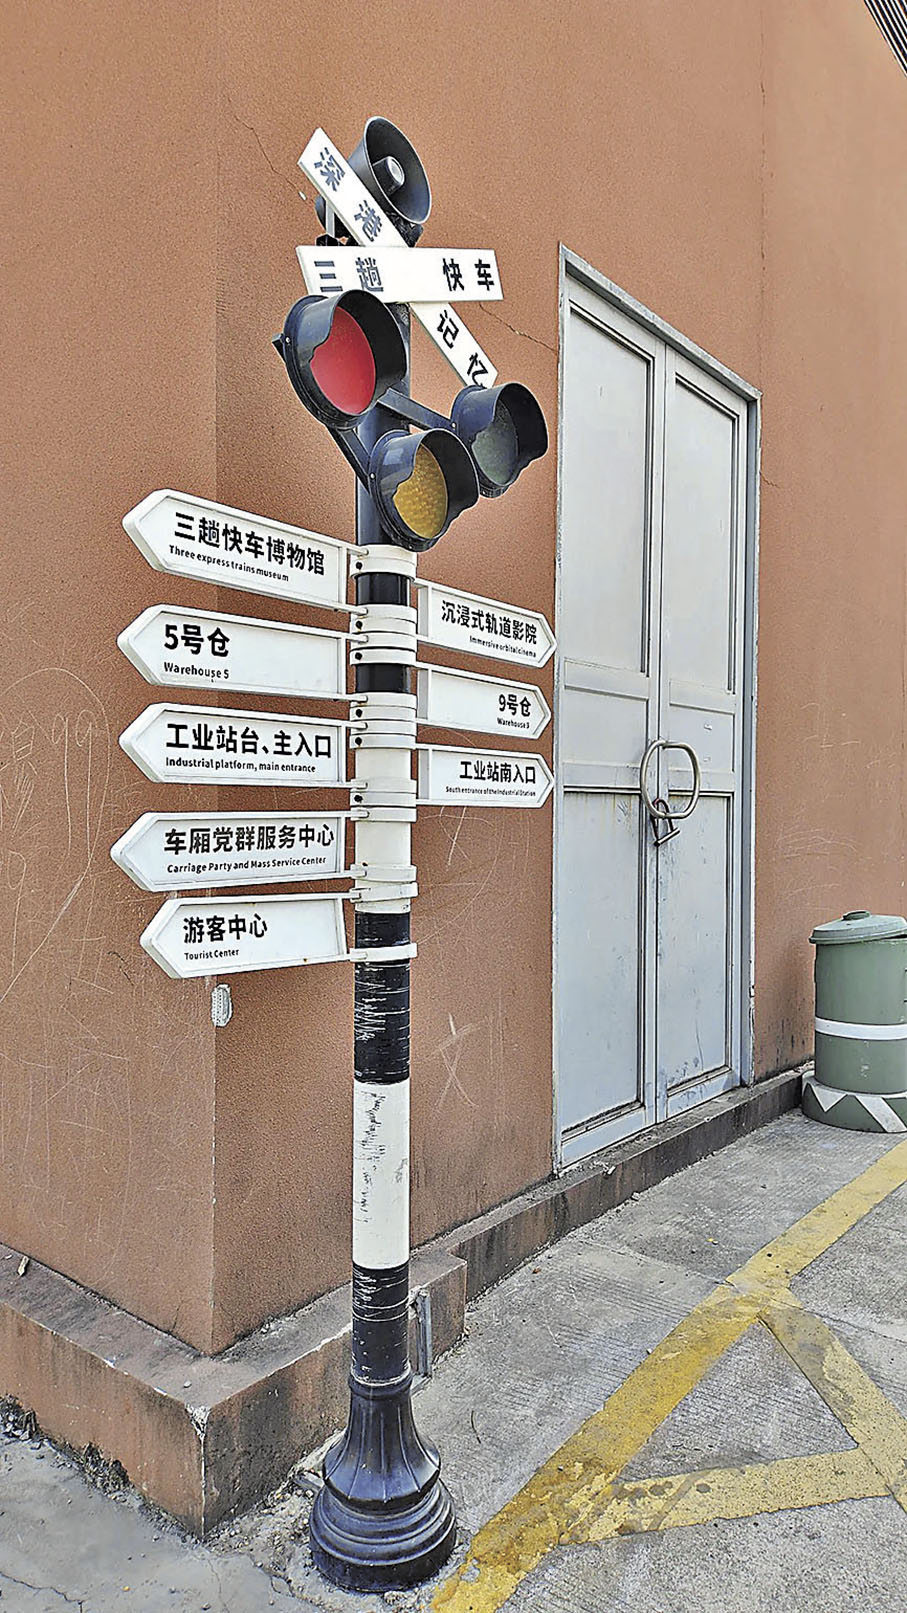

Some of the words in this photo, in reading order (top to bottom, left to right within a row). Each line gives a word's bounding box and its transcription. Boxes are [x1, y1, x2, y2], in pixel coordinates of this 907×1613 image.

[314, 147, 383, 242] 深港
[175, 512, 325, 575] 三趟快车博物馆
[169, 545, 195, 559] Three
[197, 553, 230, 568] express
[230, 561, 255, 574] trains
[256, 569, 289, 581] museum
[441, 600, 537, 645] 沉浸式轨道影院
[164, 624, 230, 657] 5号仓
[163, 662, 222, 678] Warehouse
[223, 669, 229, 679] 5
[499, 694, 531, 717] 9号仓
[497, 717, 525, 728] Warehouse
[166, 723, 331, 758] 工业站台、主入口
[166, 757, 214, 768] Industrial
[215, 759, 257, 771] platform,
[259, 762, 280, 771] main
[281, 763, 316, 773] entrance
[460, 760, 536, 784] 工业站南入口
[164, 823, 335, 855] 车厢党群服务中心
[167, 862, 207, 874] Carriage
[208, 861, 232, 872] Party
[233, 860, 249, 869] and
[250, 860, 270, 868] Mass
[272, 857, 300, 867] Service
[301, 856, 326, 865] Center
[183, 913, 267, 944] 游客中心
[184, 950, 213, 960] Tourist
[214, 948, 239, 958] Center
